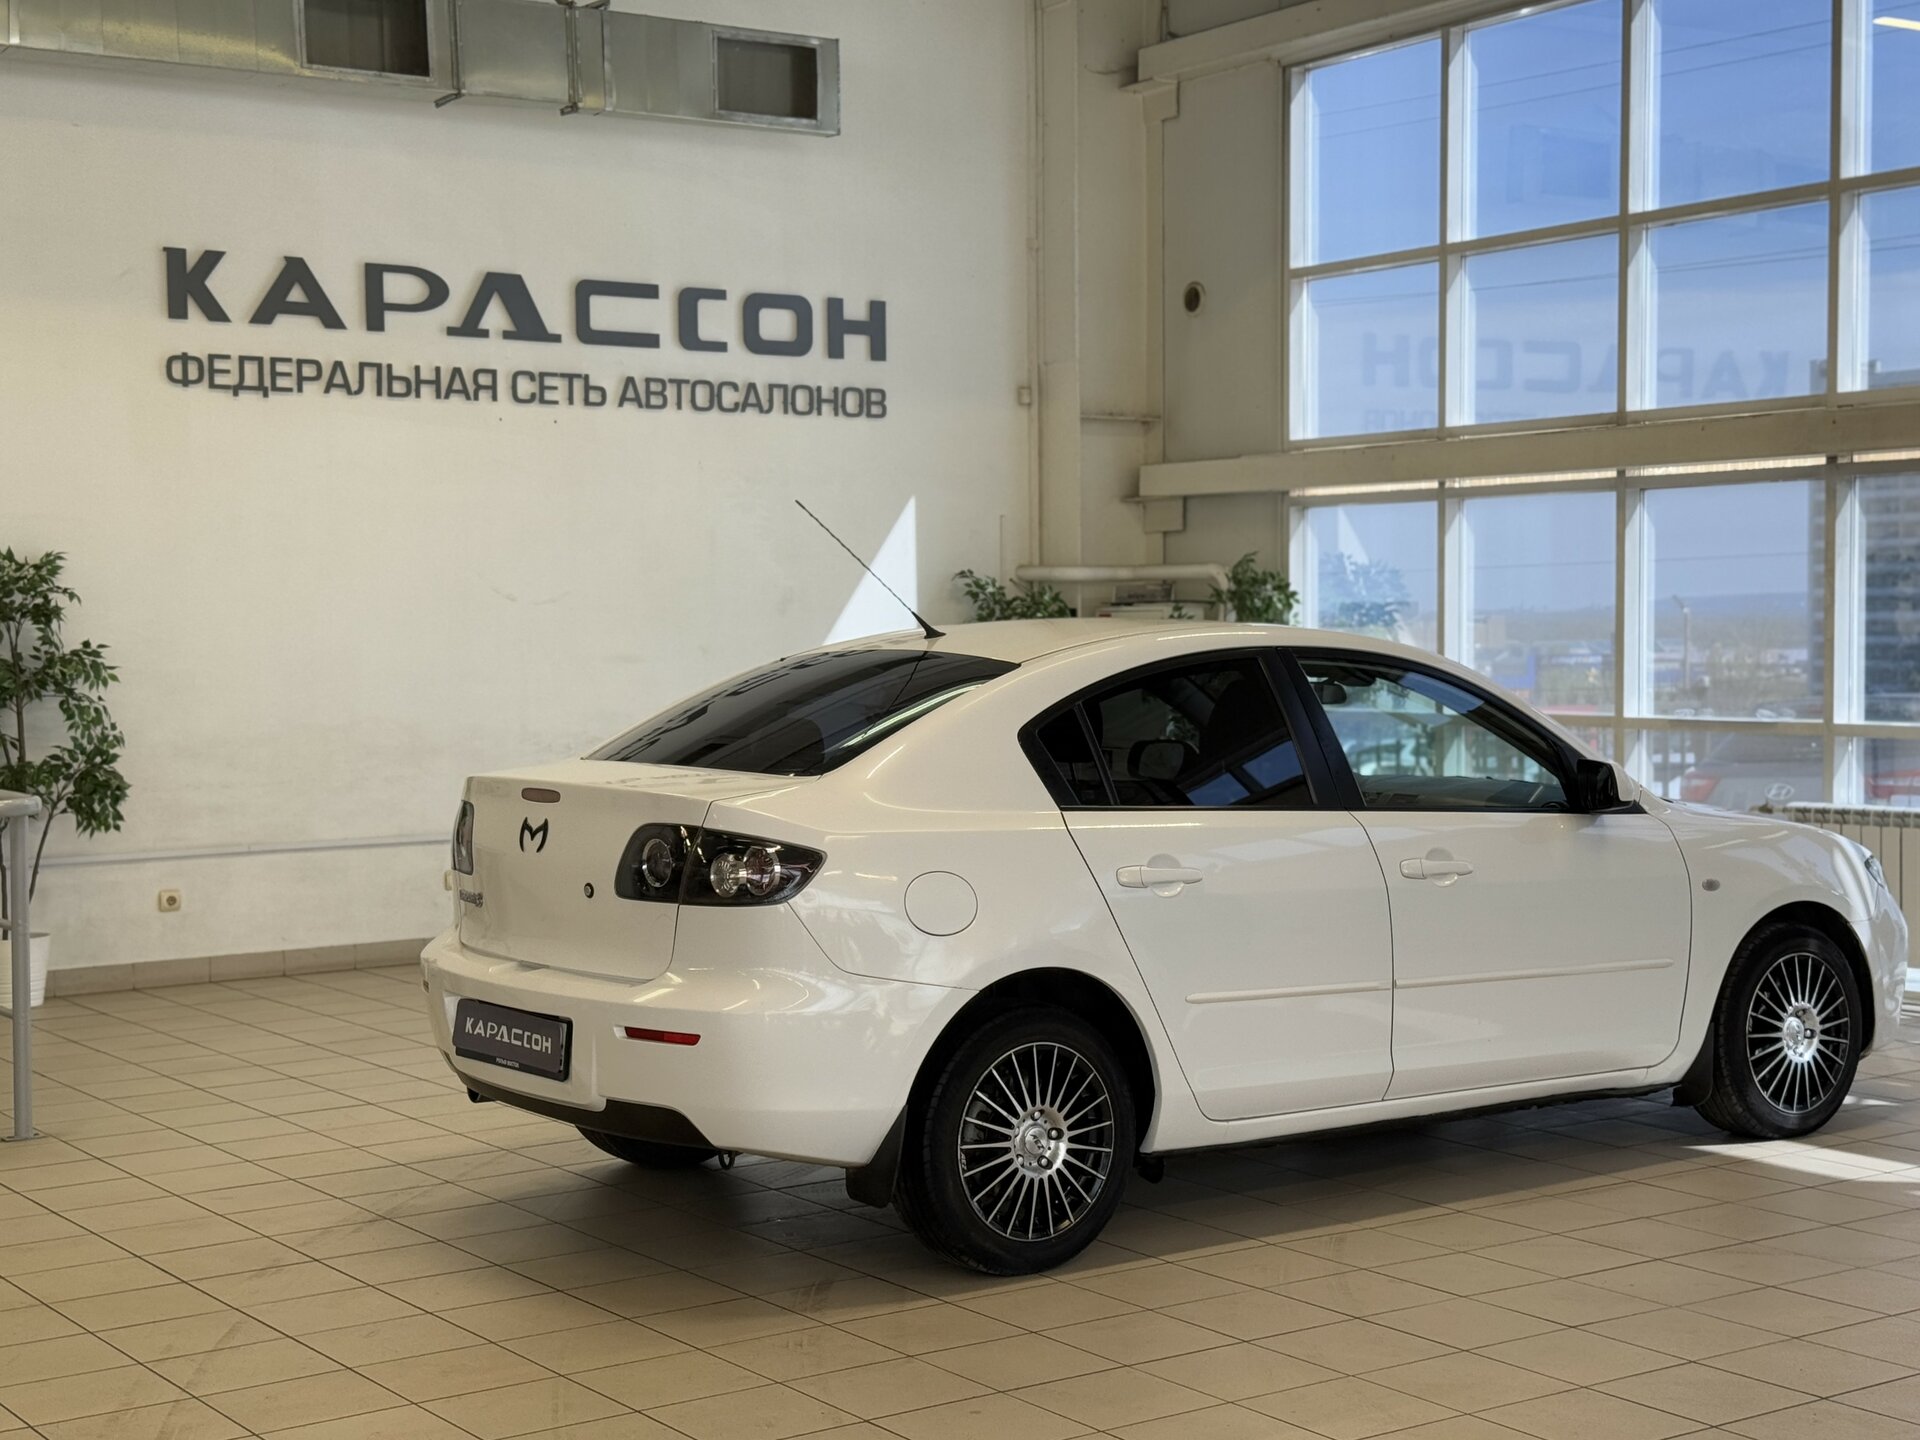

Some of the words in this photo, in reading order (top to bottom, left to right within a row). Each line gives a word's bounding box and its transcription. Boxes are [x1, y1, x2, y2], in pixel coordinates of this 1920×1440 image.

[162, 246, 888, 362] КАРЛССОН
[165, 351, 498, 403] ФЕДЕРАЛЬНАЯ
[511, 370, 607, 408] СЕТЬ
[617, 375, 888, 420] АВТОСАЛОНОВ
[464, 1016, 552, 1055] КАРЛССОН
